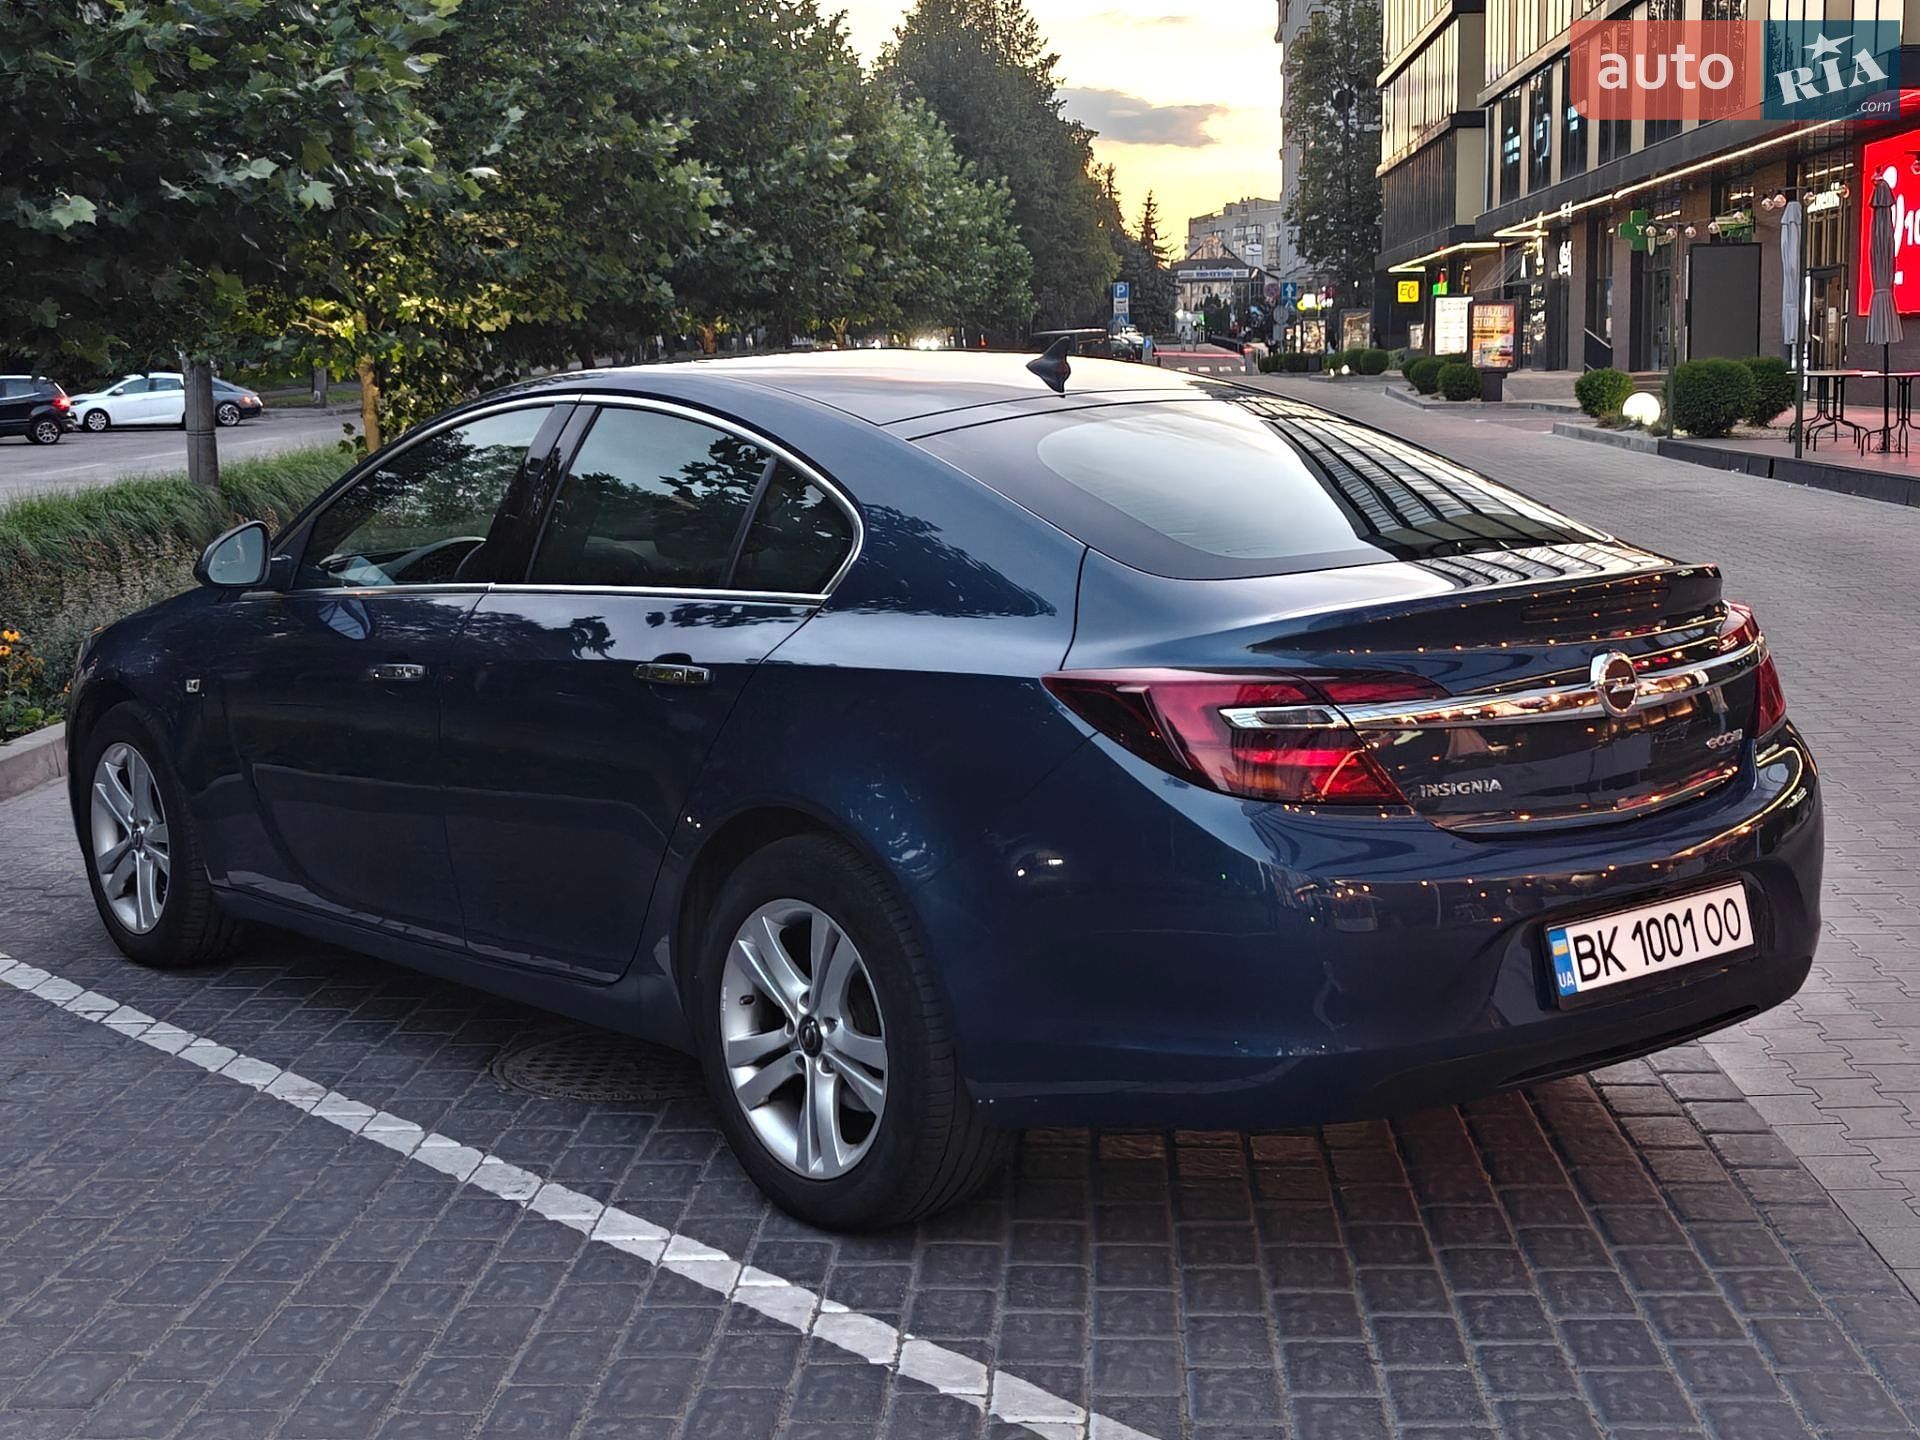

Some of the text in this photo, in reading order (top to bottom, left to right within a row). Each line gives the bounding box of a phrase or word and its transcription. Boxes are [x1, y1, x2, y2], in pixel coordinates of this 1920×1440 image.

[1419, 779, 1503, 798] INSIGNIA
[1573, 926, 1627, 982] BK
[1632, 908, 1699, 965] 1001
[1558, 972, 1575, 988] UA
